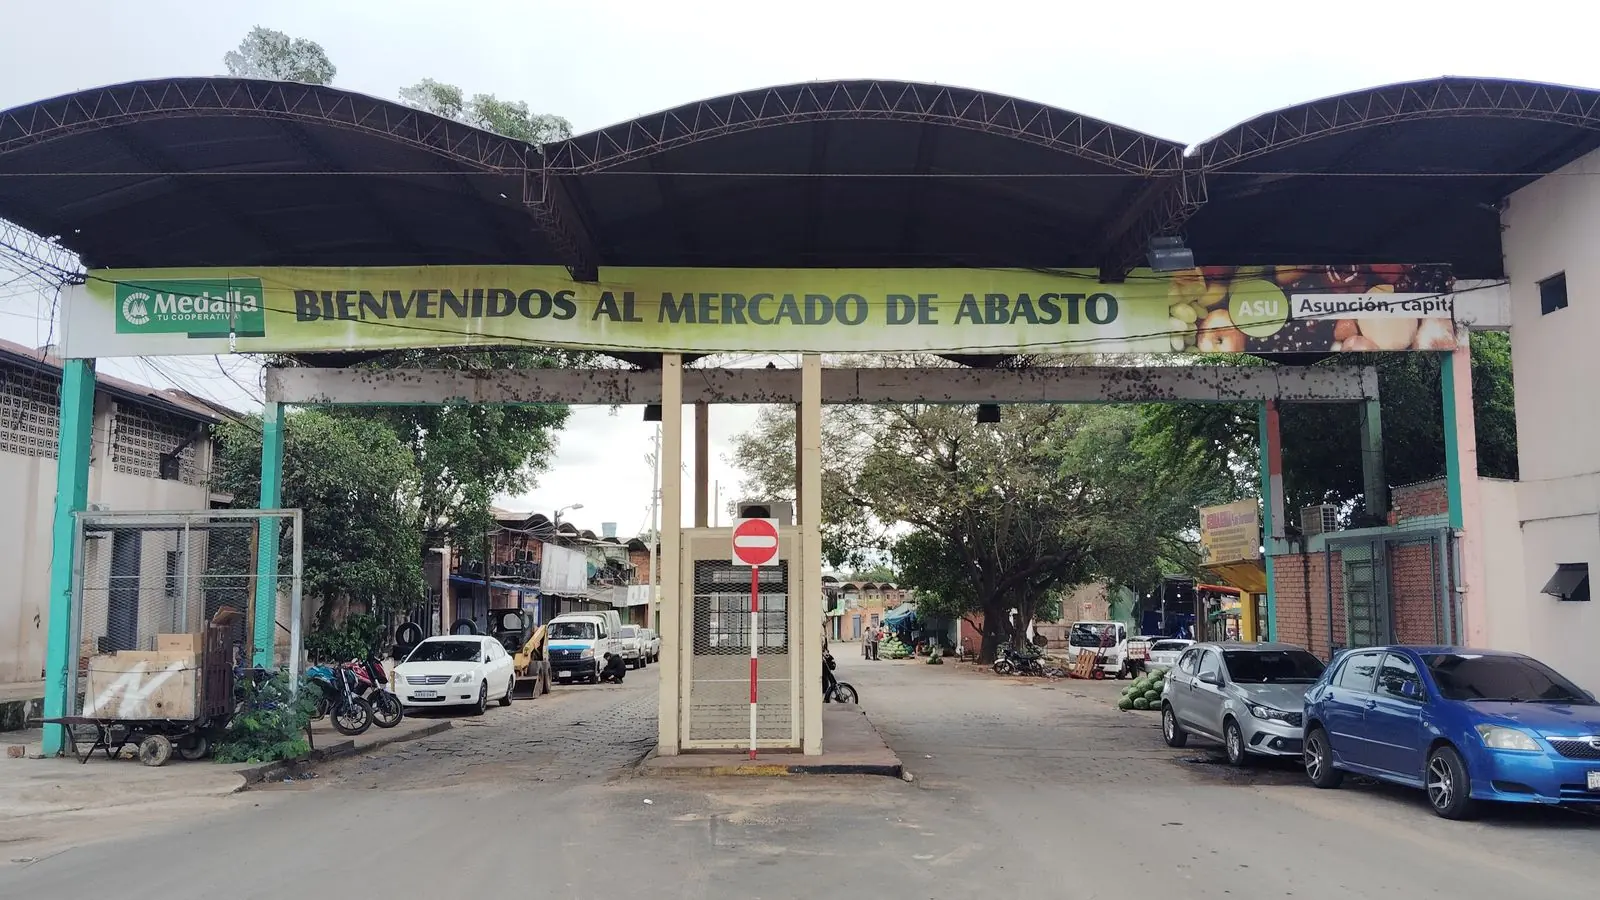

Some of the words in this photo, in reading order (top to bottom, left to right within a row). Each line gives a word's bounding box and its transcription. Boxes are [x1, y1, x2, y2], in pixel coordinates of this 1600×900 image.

[153, 291, 258, 314] Medalla
[294, 288, 577, 322] BIENVENIDOS
[592, 291, 643, 322] AL
[657, 292, 869, 325] MERCADO
[886, 293, 939, 325] DE
[954, 292, 1119, 325] ABASTO
[1238, 299, 1278, 317] ASU
[1299, 295, 1395, 314] Asunción,
[157, 313, 169, 321] TU
